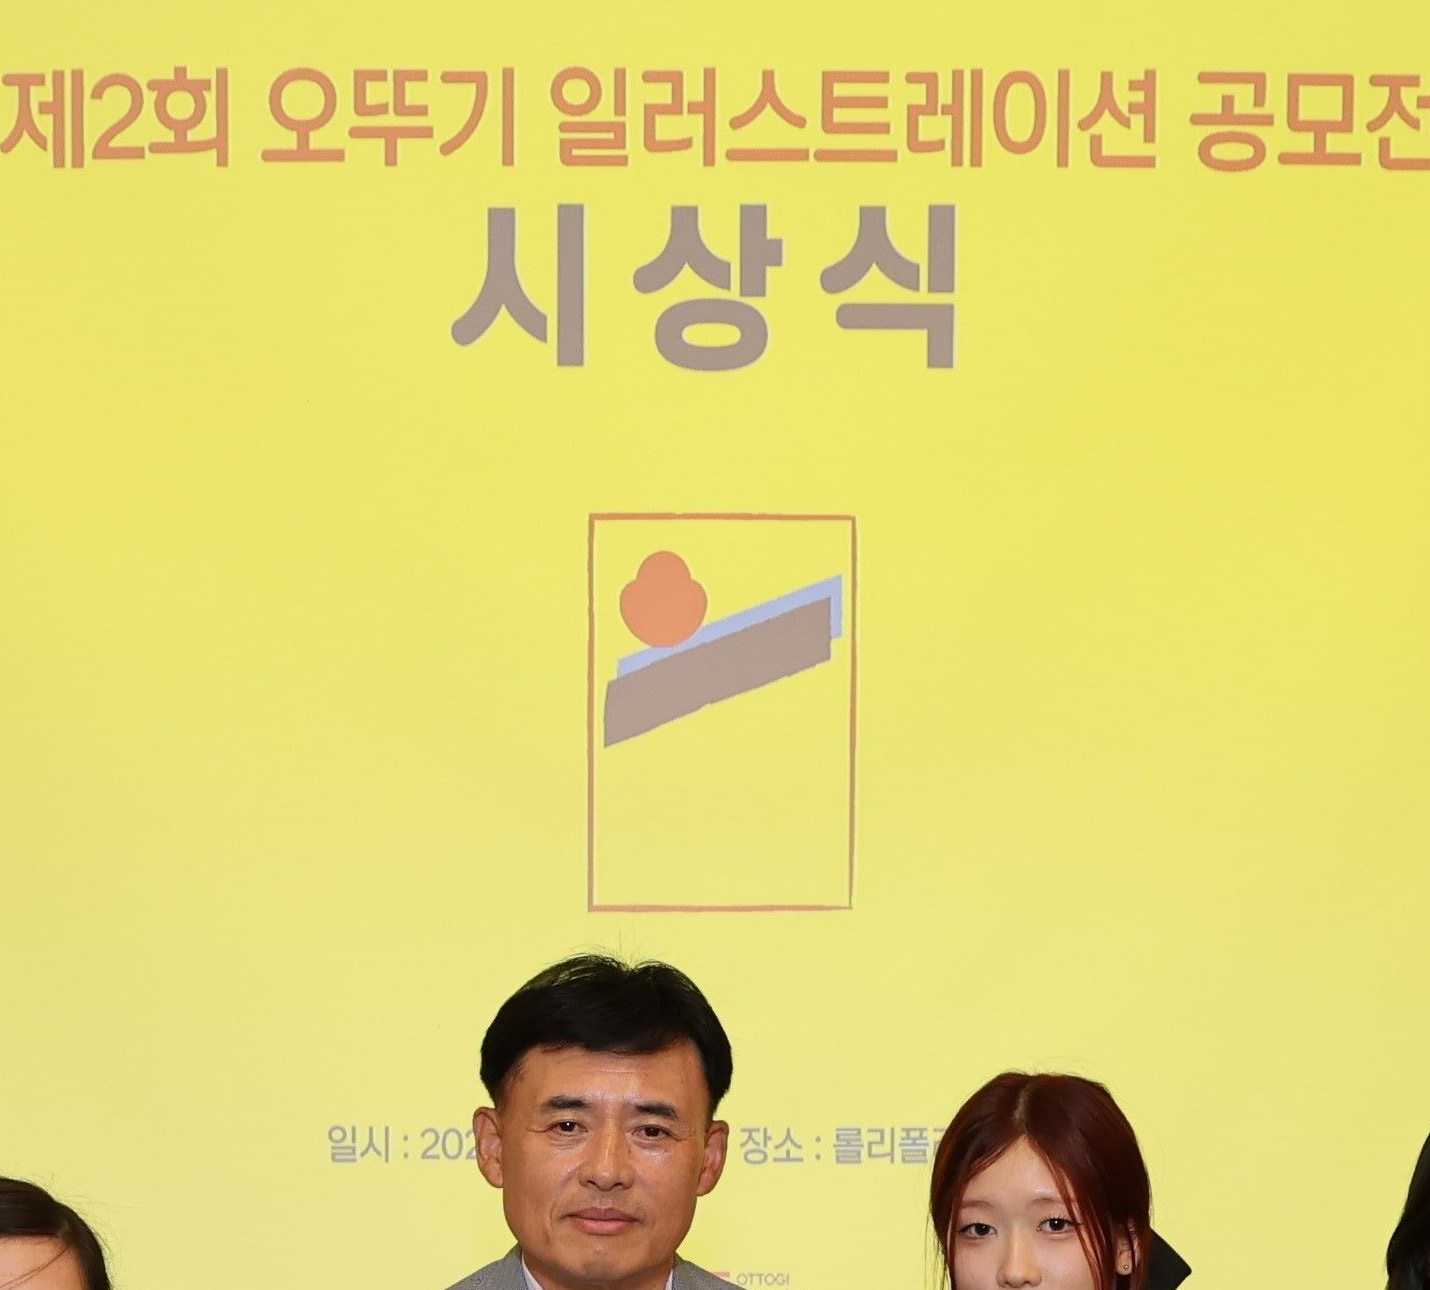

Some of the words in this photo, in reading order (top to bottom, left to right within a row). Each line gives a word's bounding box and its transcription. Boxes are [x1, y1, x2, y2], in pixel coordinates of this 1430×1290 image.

[0, 66, 229, 169] 제2회
[261, 67, 514, 167] 오뚜기
[550, 66, 1156, 168] 일러스트레이션
[326, 1125, 390, 1164] 일시
[739, 1125, 805, 1164] 장소
[736, 1272, 790, 1286] OTTOGI
